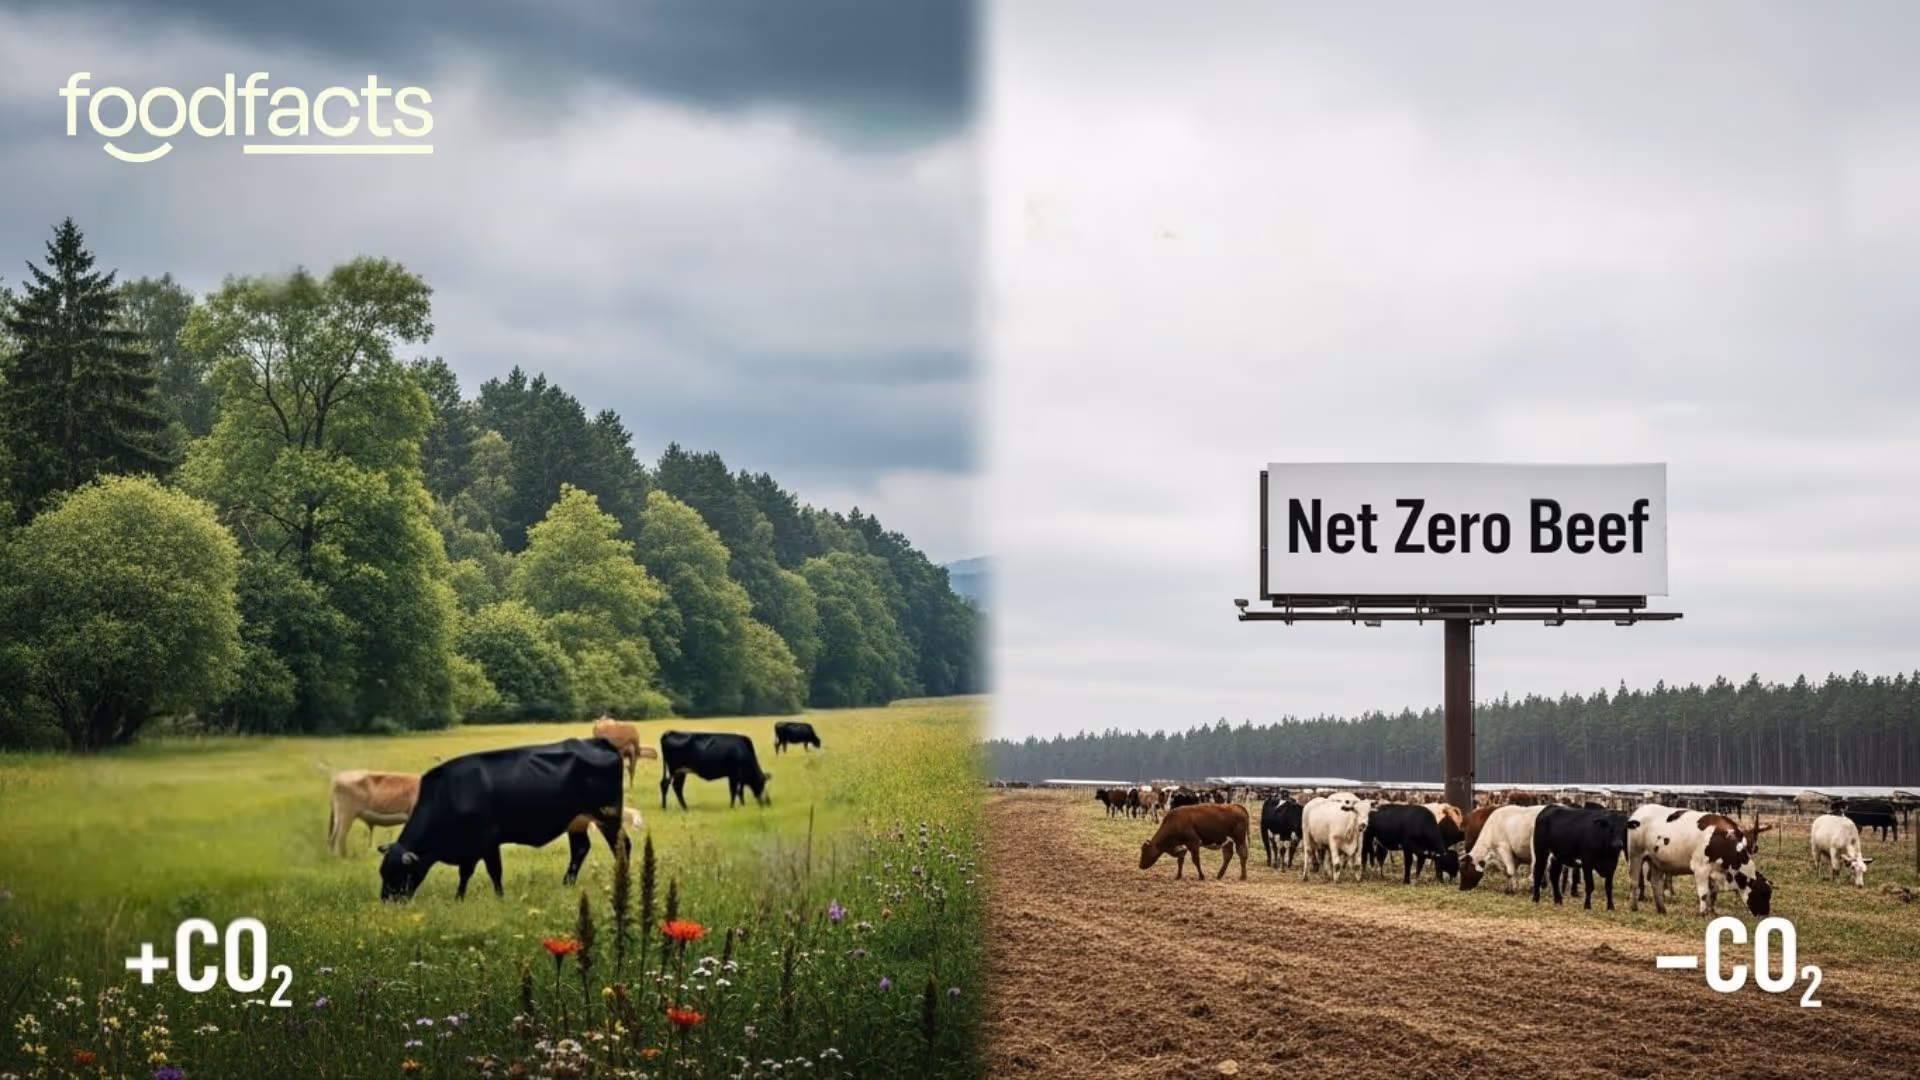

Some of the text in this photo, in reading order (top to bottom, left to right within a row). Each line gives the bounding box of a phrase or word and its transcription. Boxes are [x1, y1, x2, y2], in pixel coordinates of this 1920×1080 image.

[1288, 498, 1650, 554] Net Zero Beef
